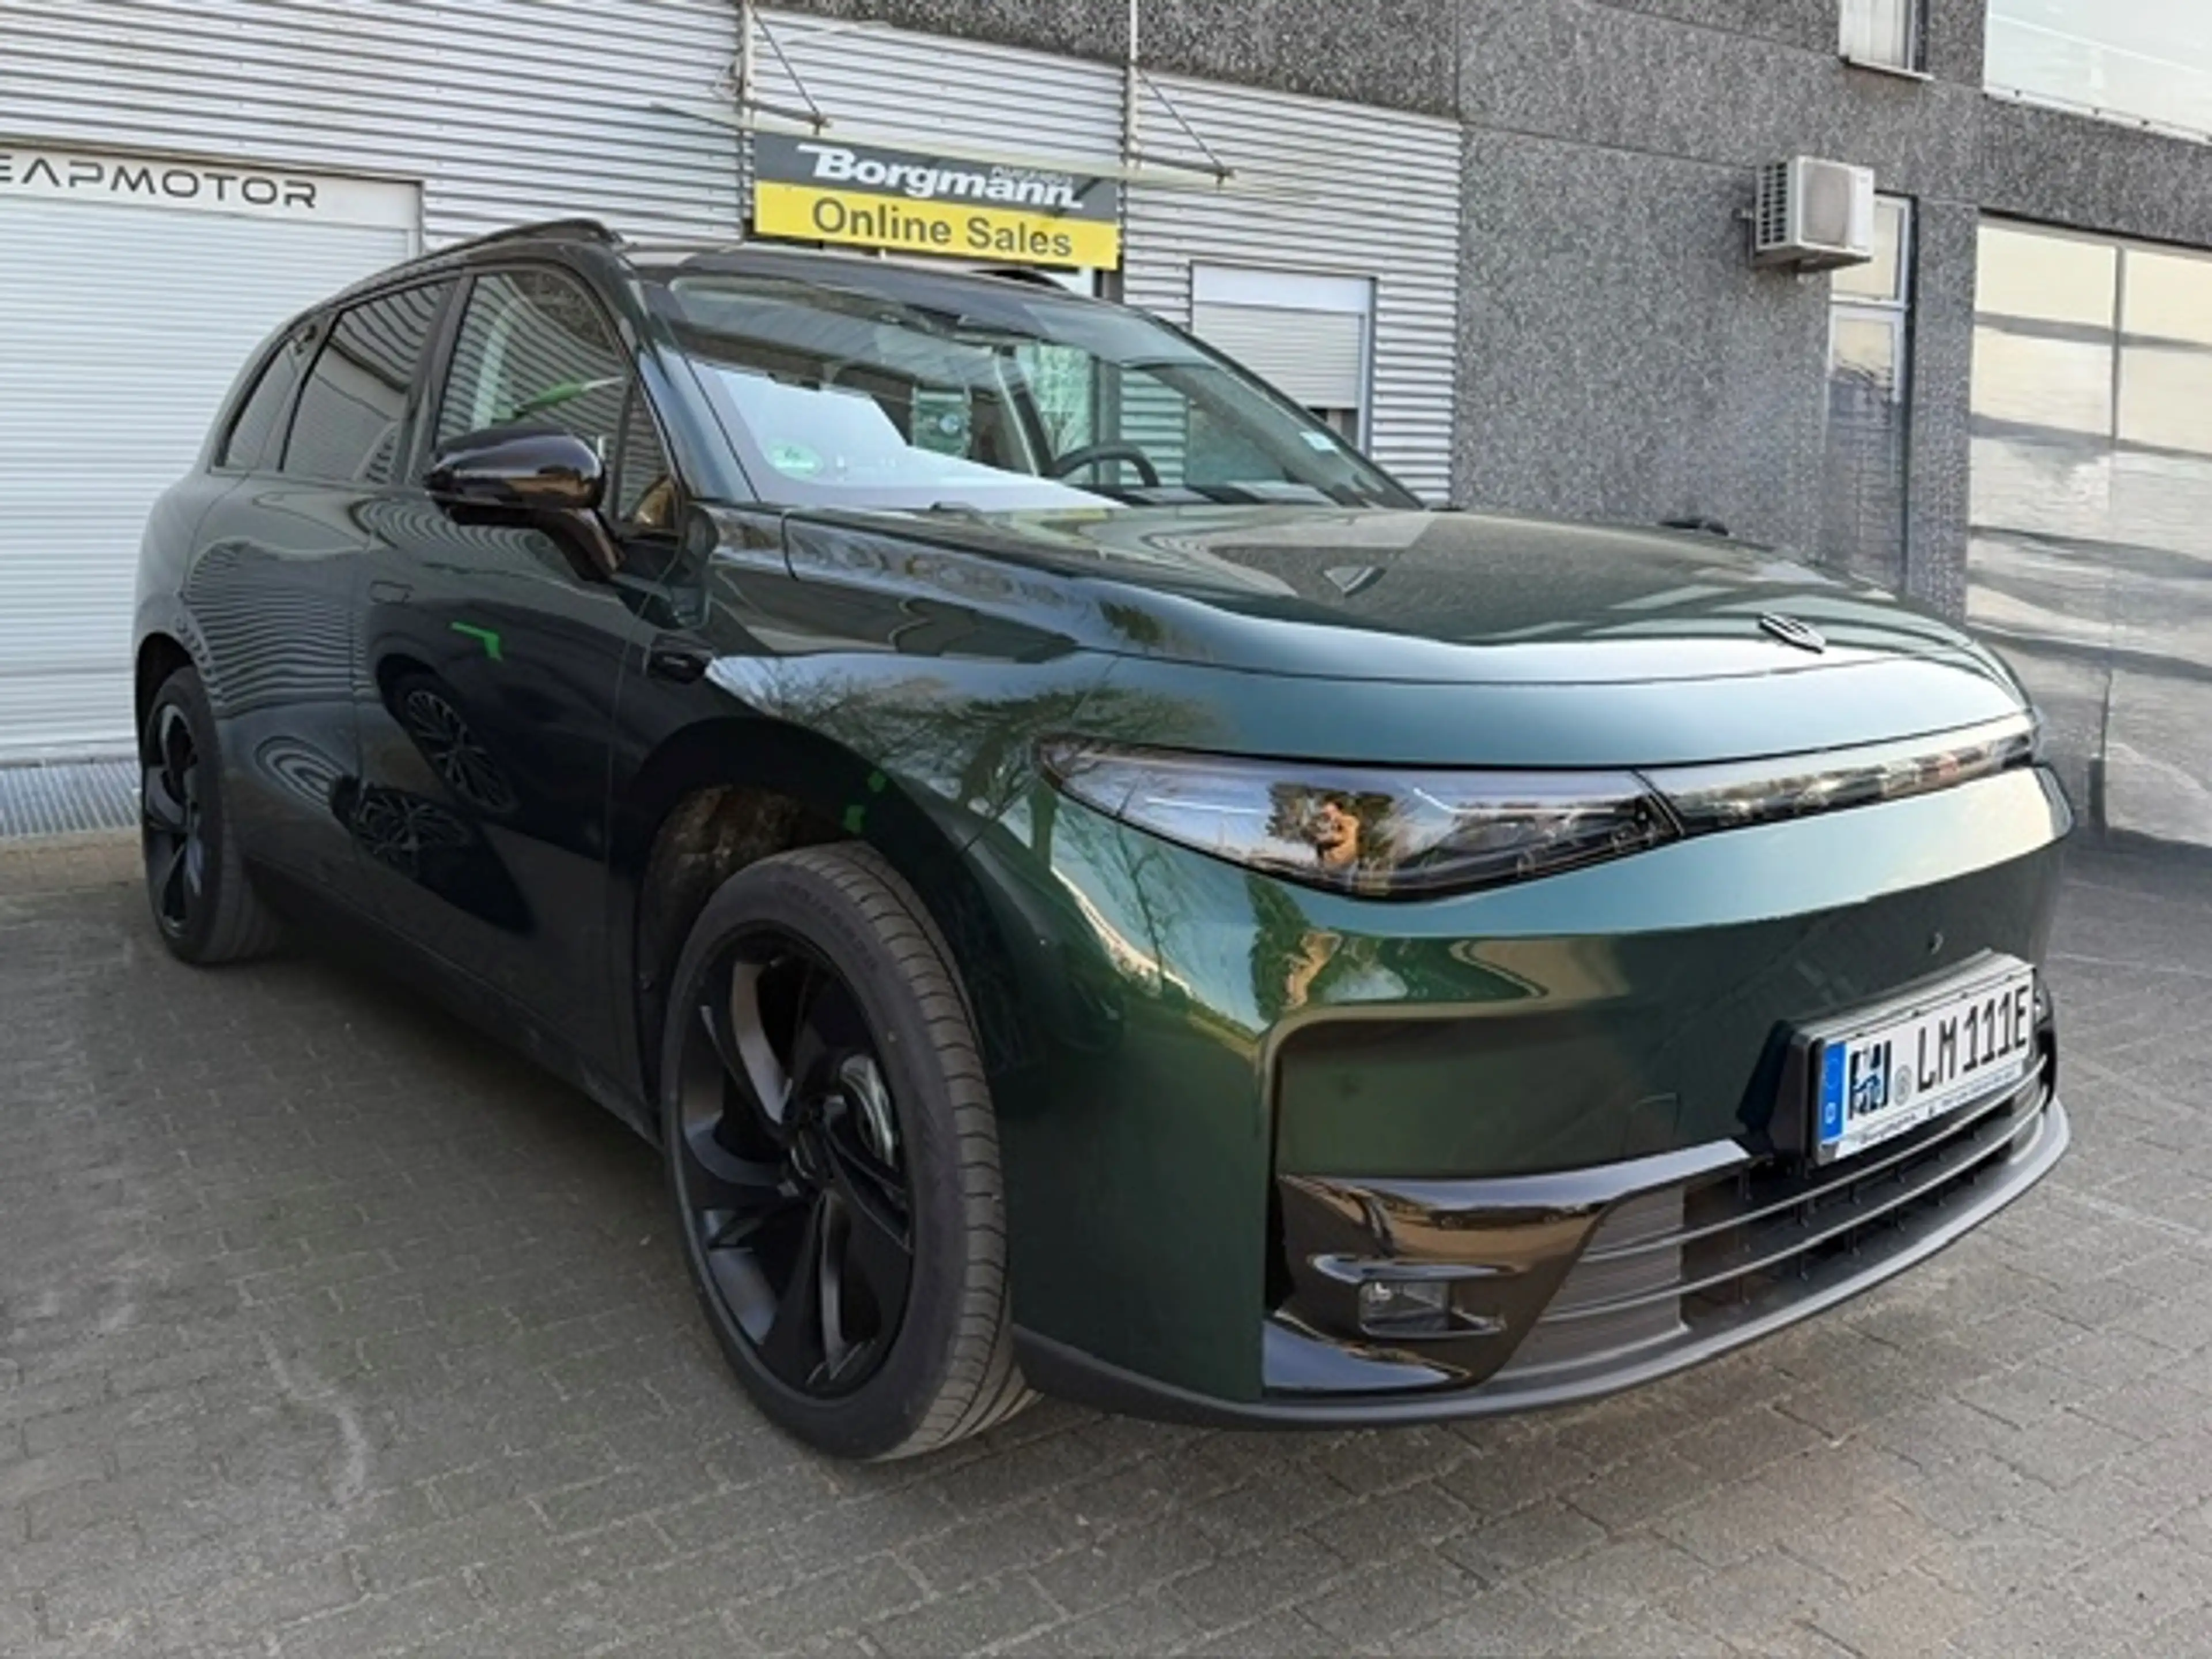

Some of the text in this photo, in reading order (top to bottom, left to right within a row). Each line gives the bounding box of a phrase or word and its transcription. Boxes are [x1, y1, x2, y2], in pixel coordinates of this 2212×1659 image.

[798, 143, 1084, 210] Borgmann
[813, 197, 1073, 257] Online Sales
